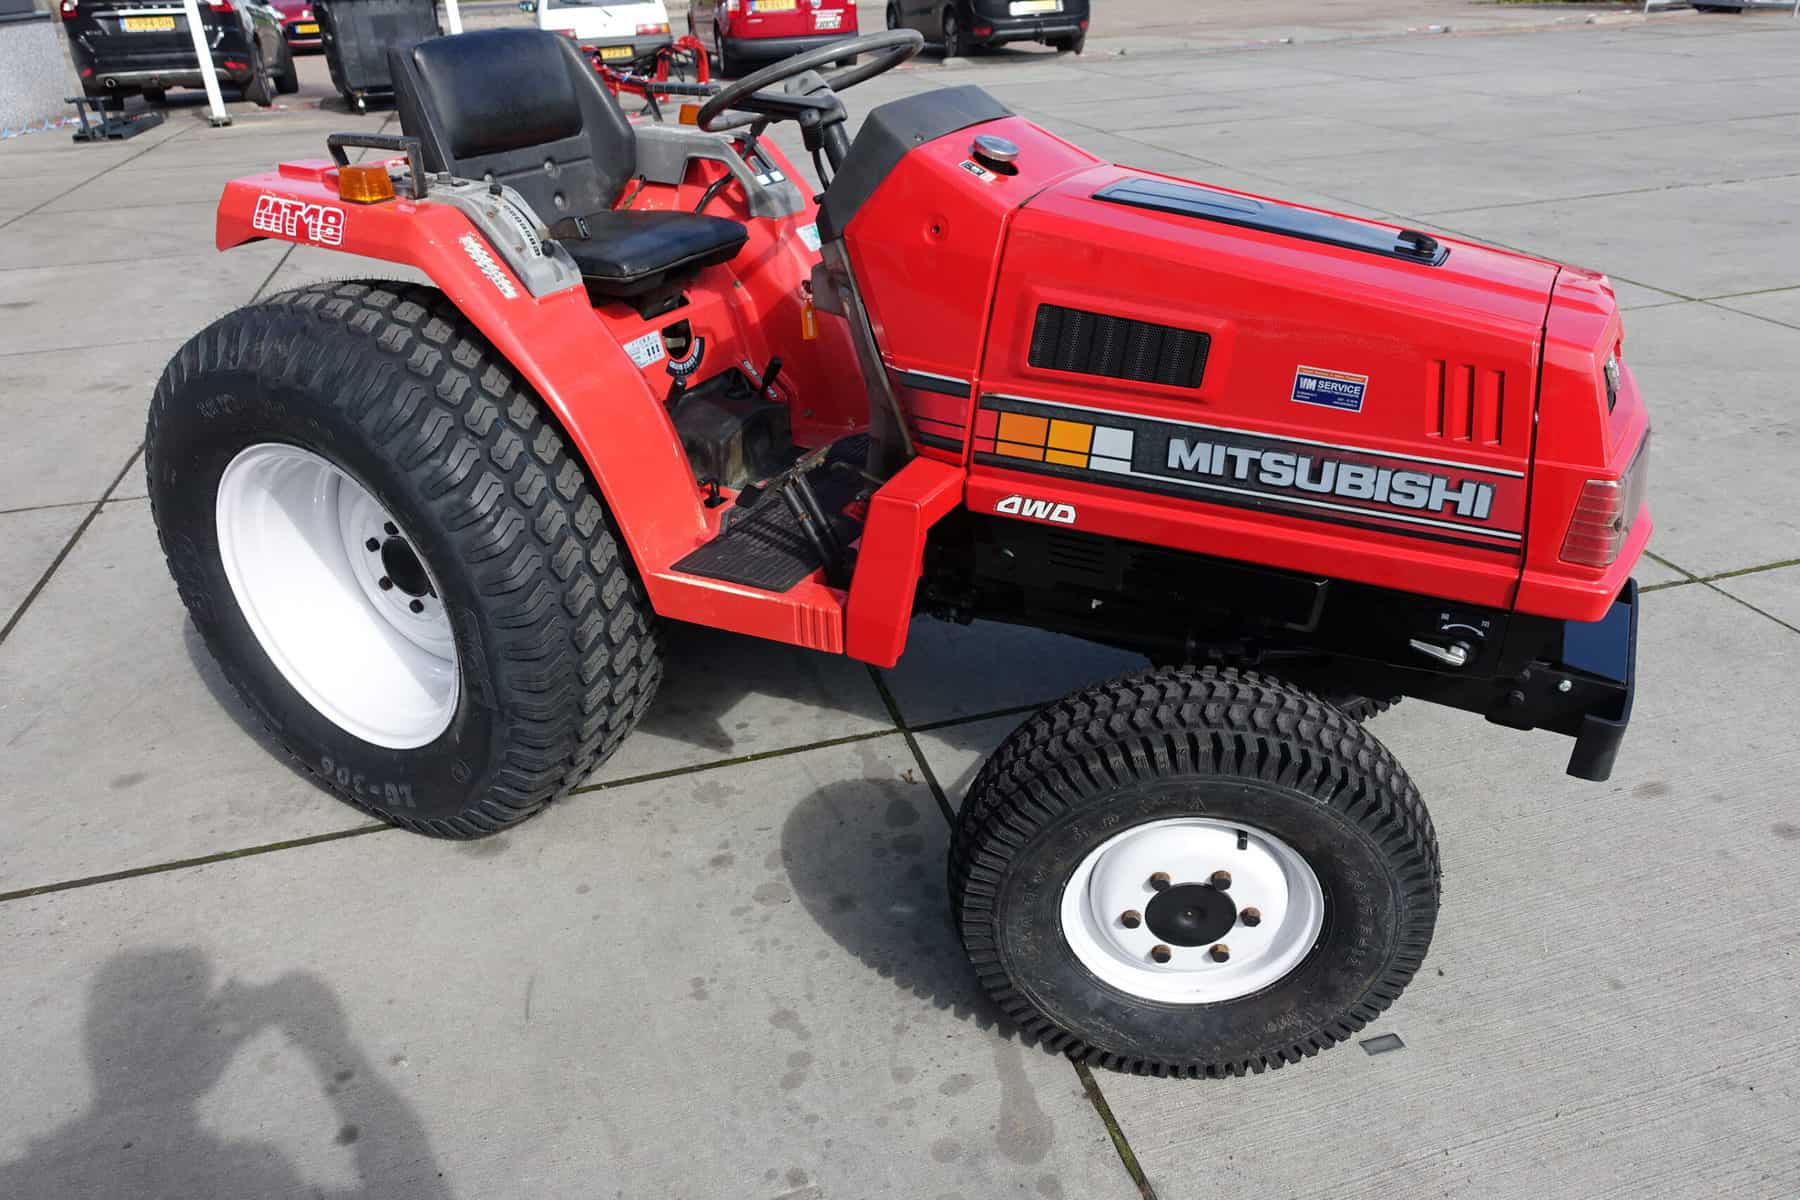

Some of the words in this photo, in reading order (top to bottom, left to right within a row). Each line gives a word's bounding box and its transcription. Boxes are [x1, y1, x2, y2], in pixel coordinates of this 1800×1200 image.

[253, 195, 344, 245] MT18
[1318, 381, 1362, 395] SERVICE
[1167, 438, 1494, 519] MITSUBISHI
[996, 494, 1076, 524] 4WD
